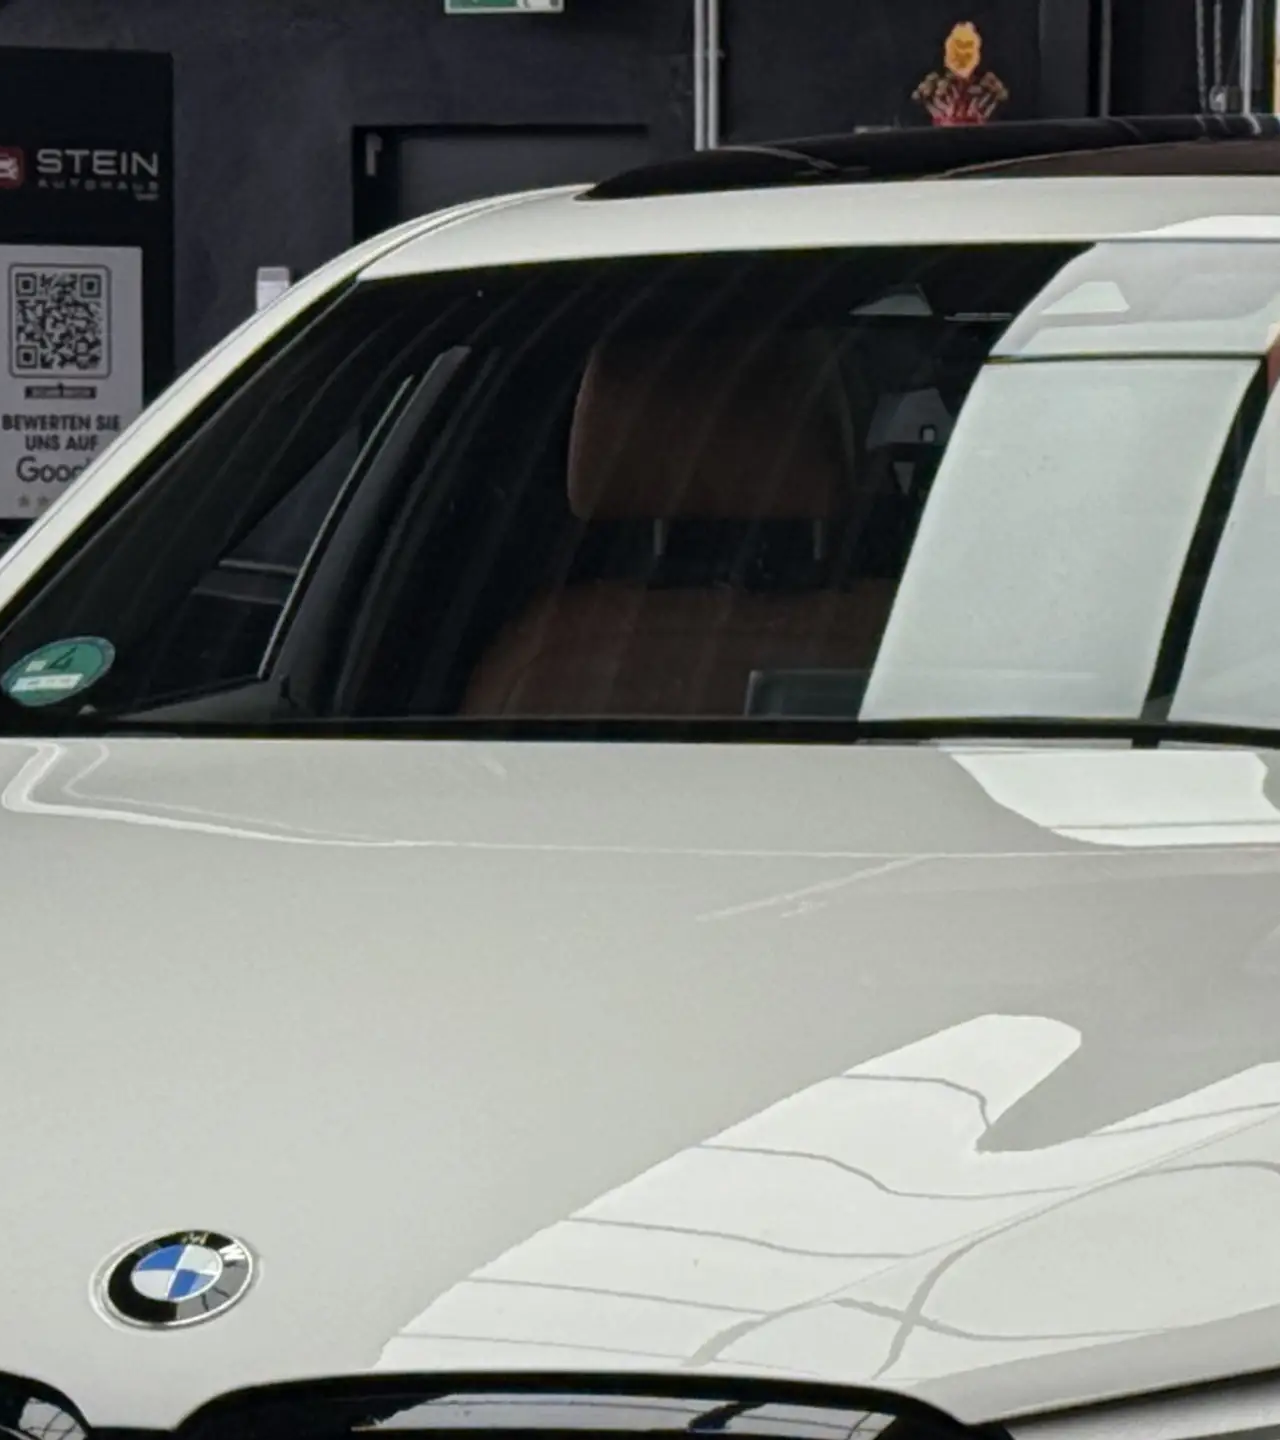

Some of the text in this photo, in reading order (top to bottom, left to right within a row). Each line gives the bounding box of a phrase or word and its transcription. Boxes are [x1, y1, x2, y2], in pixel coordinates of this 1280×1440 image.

[36, 149, 159, 177] STEIN
[2, 414, 120, 431] BEWERTEN SIE
[25, 434, 99, 452] UNS AUF
